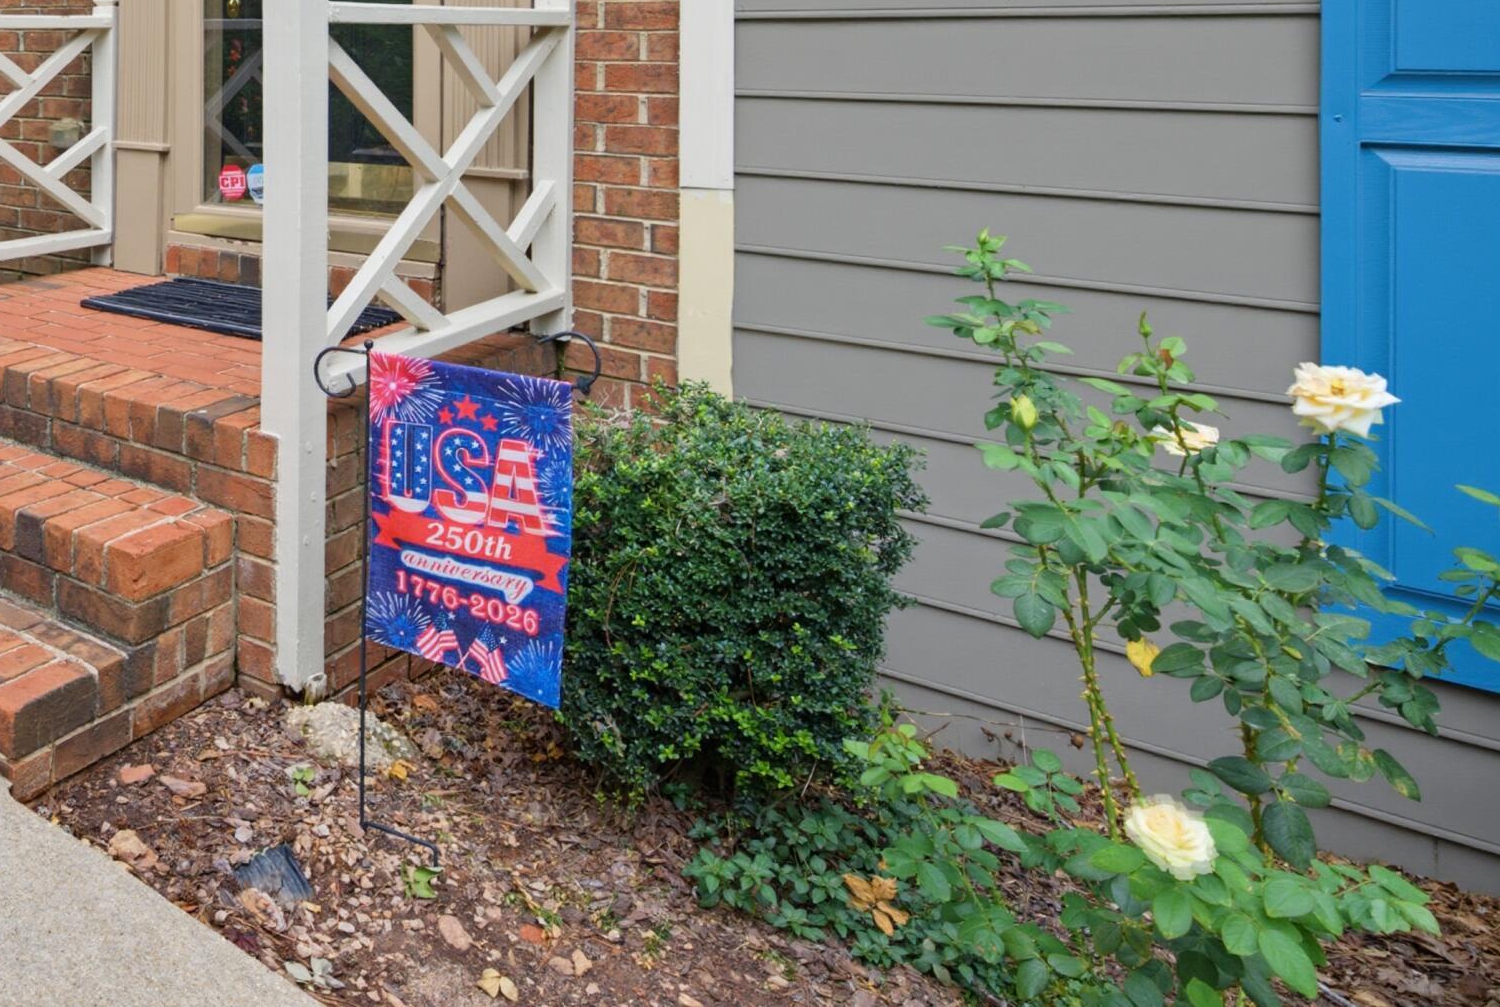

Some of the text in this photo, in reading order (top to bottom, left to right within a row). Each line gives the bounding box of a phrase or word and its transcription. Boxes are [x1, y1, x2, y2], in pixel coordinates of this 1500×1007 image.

[220, 176, 245, 188] CPI
[384, 418, 546, 536] USA
[426, 522, 512, 560] 250th
[403, 552, 528, 600] anniversary
[396, 570, 538, 635] 1776-2026
